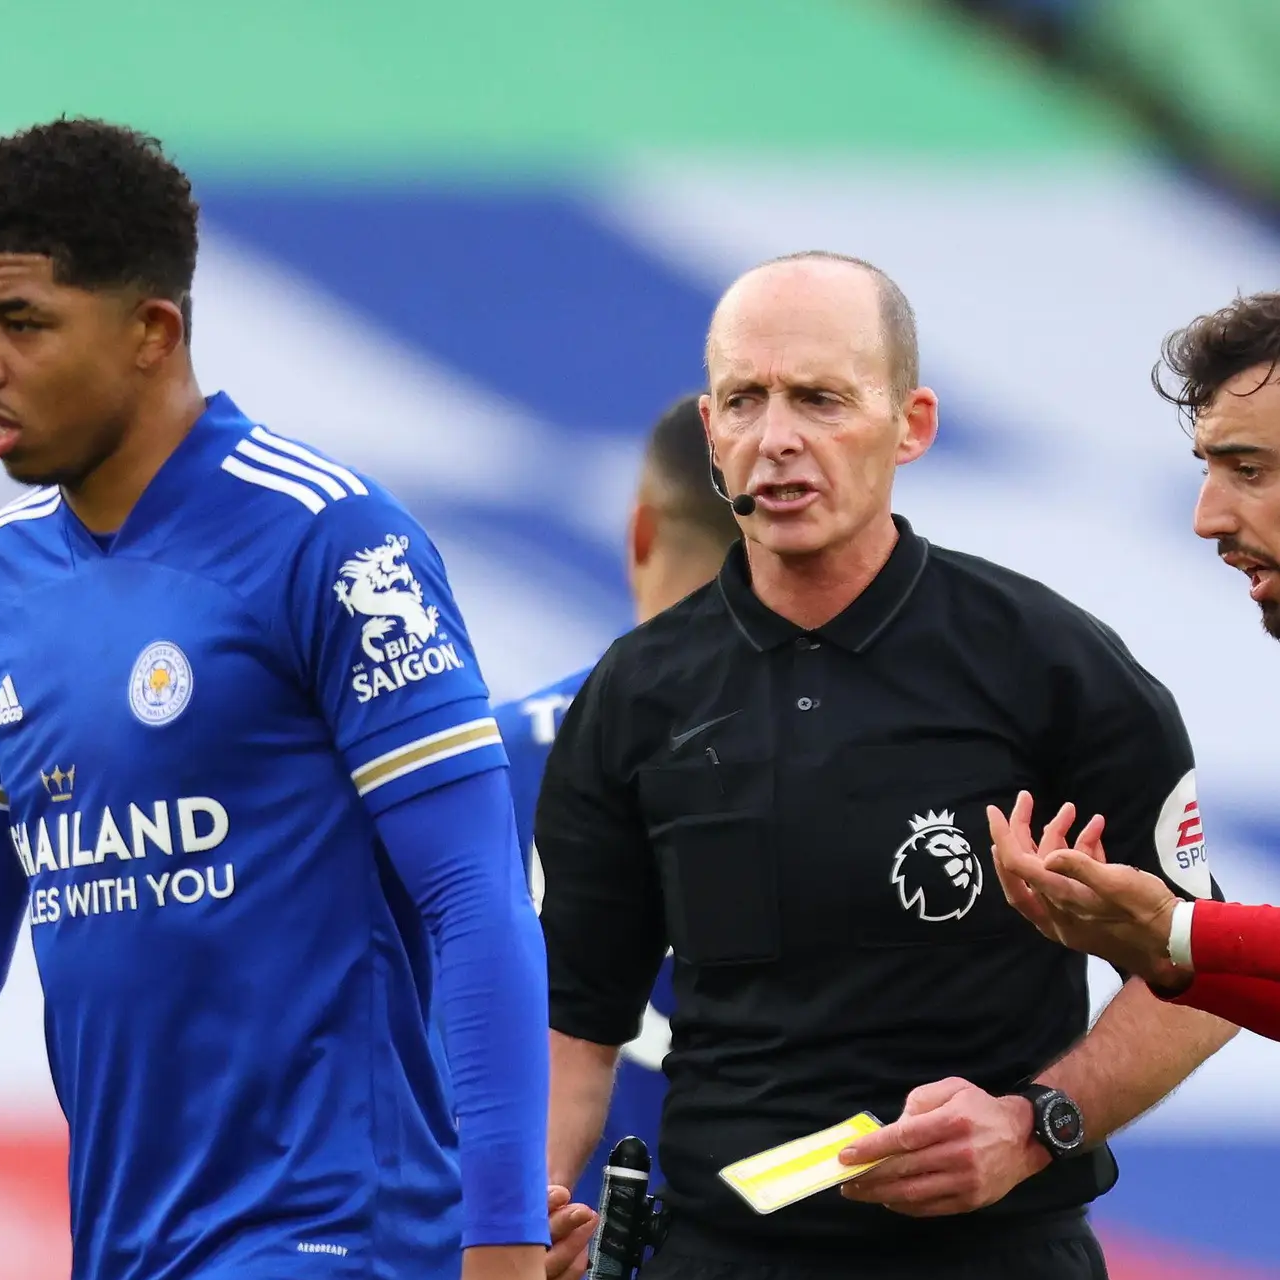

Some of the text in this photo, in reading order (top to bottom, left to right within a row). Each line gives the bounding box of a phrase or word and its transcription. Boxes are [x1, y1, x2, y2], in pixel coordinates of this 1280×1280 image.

[352, 643, 461, 704] SAIGON
[384, 633, 424, 661] BIA
[11, 797, 230, 877] HAILAND
[65, 876, 138, 918] WITH
[146, 863, 236, 907] YOU
